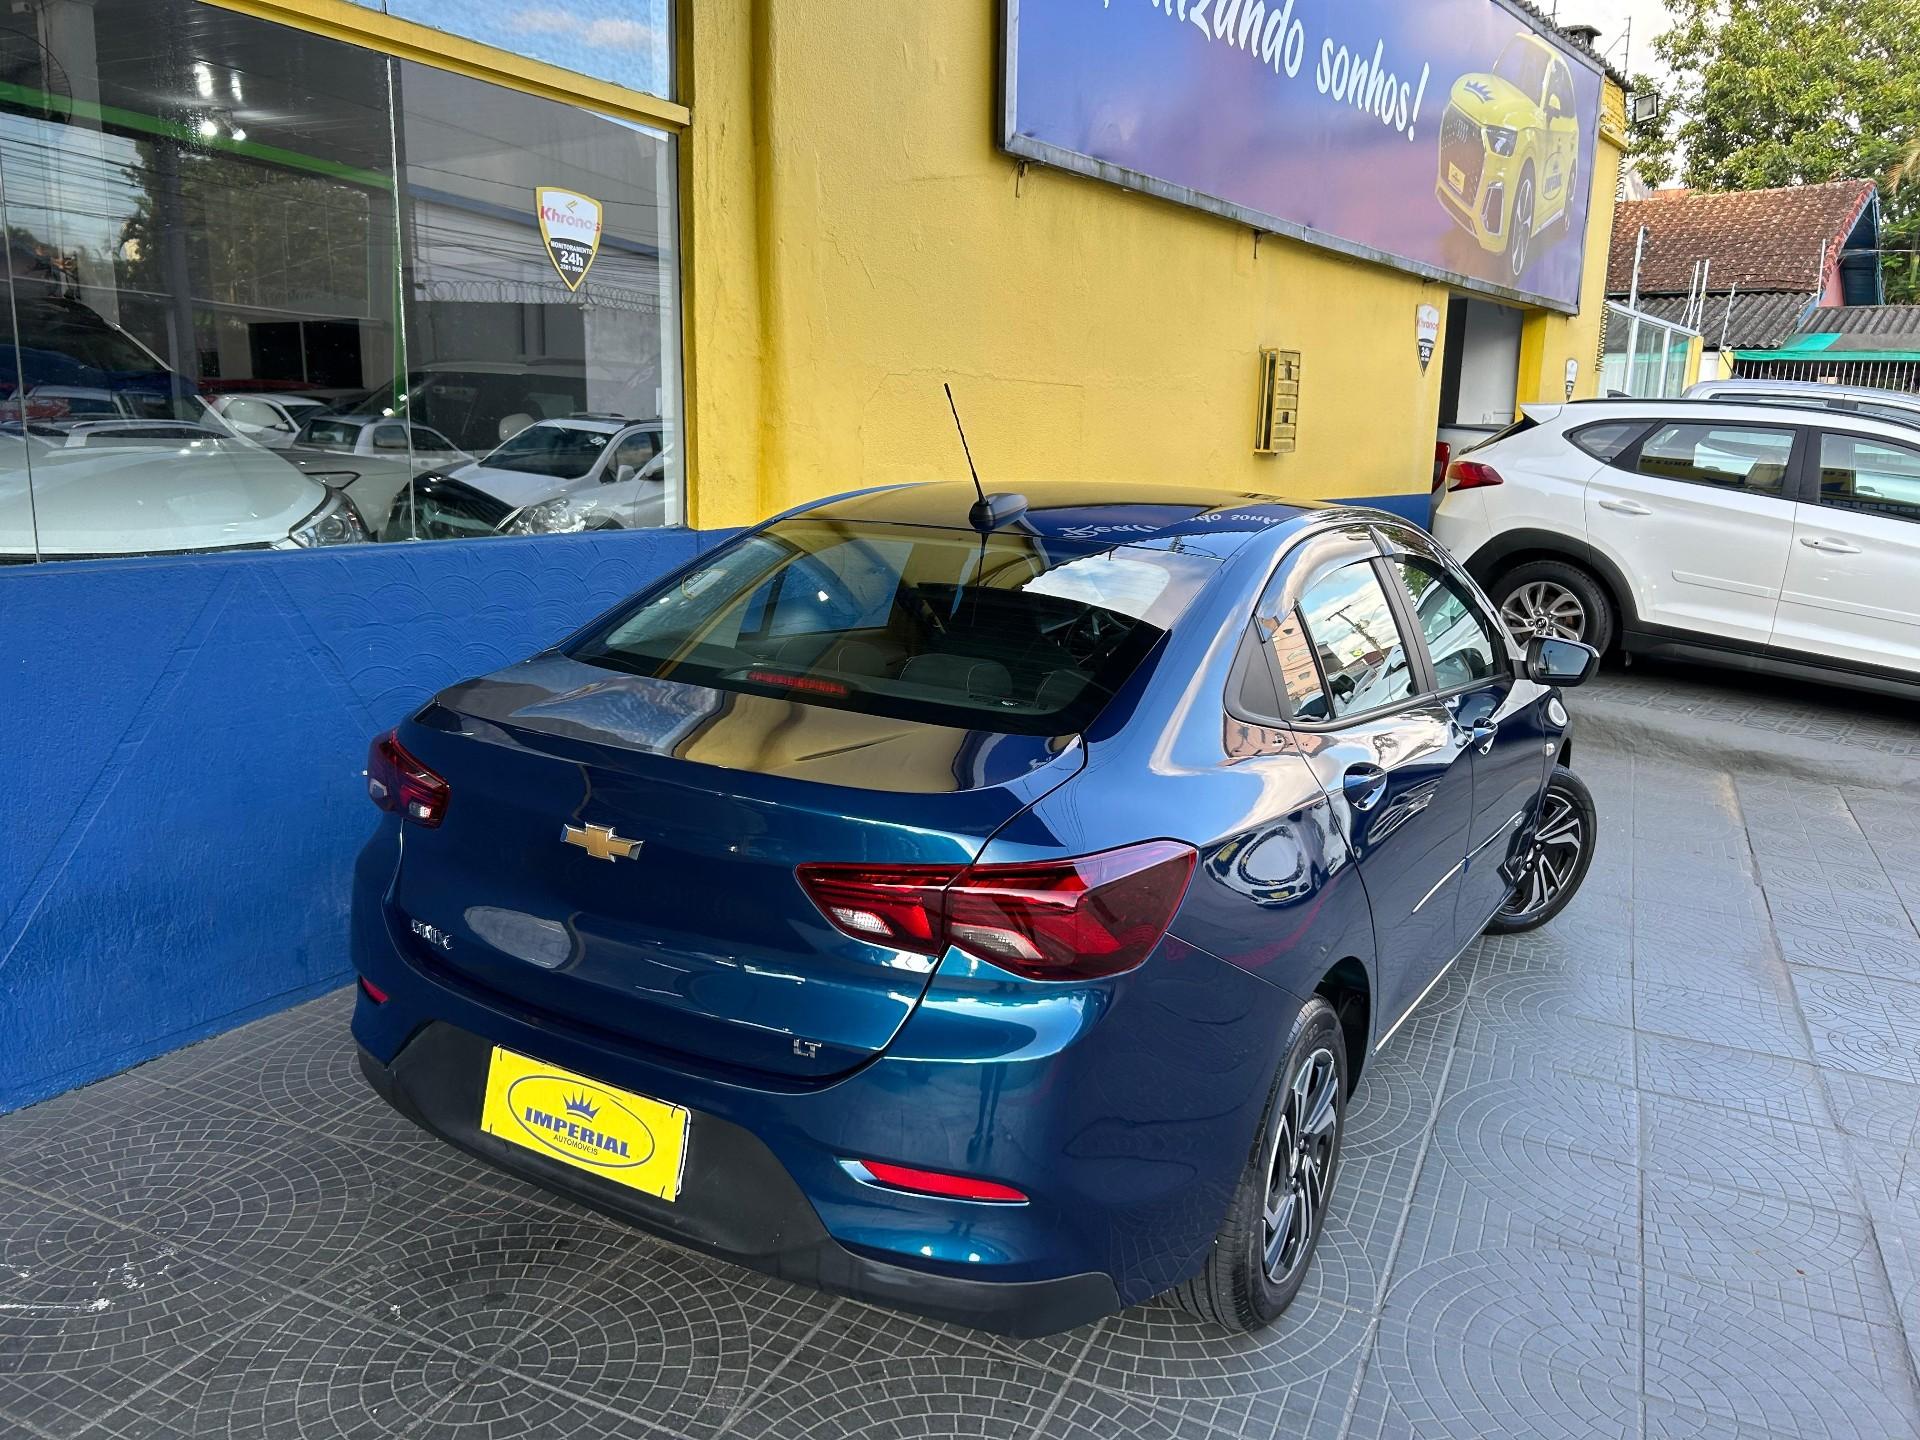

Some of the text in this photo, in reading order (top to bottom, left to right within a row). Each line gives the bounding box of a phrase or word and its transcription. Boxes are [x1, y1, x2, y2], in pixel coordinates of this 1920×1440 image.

[1315, 37, 1430, 142] sonhos!
[541, 206, 600, 232] Khronos
[550, 241, 592, 255] MONITORAMENTO
[560, 251, 583, 266] 24h
[793, 1038, 822, 1058] LT
[525, 1106, 630, 1159] IMPERIAL
